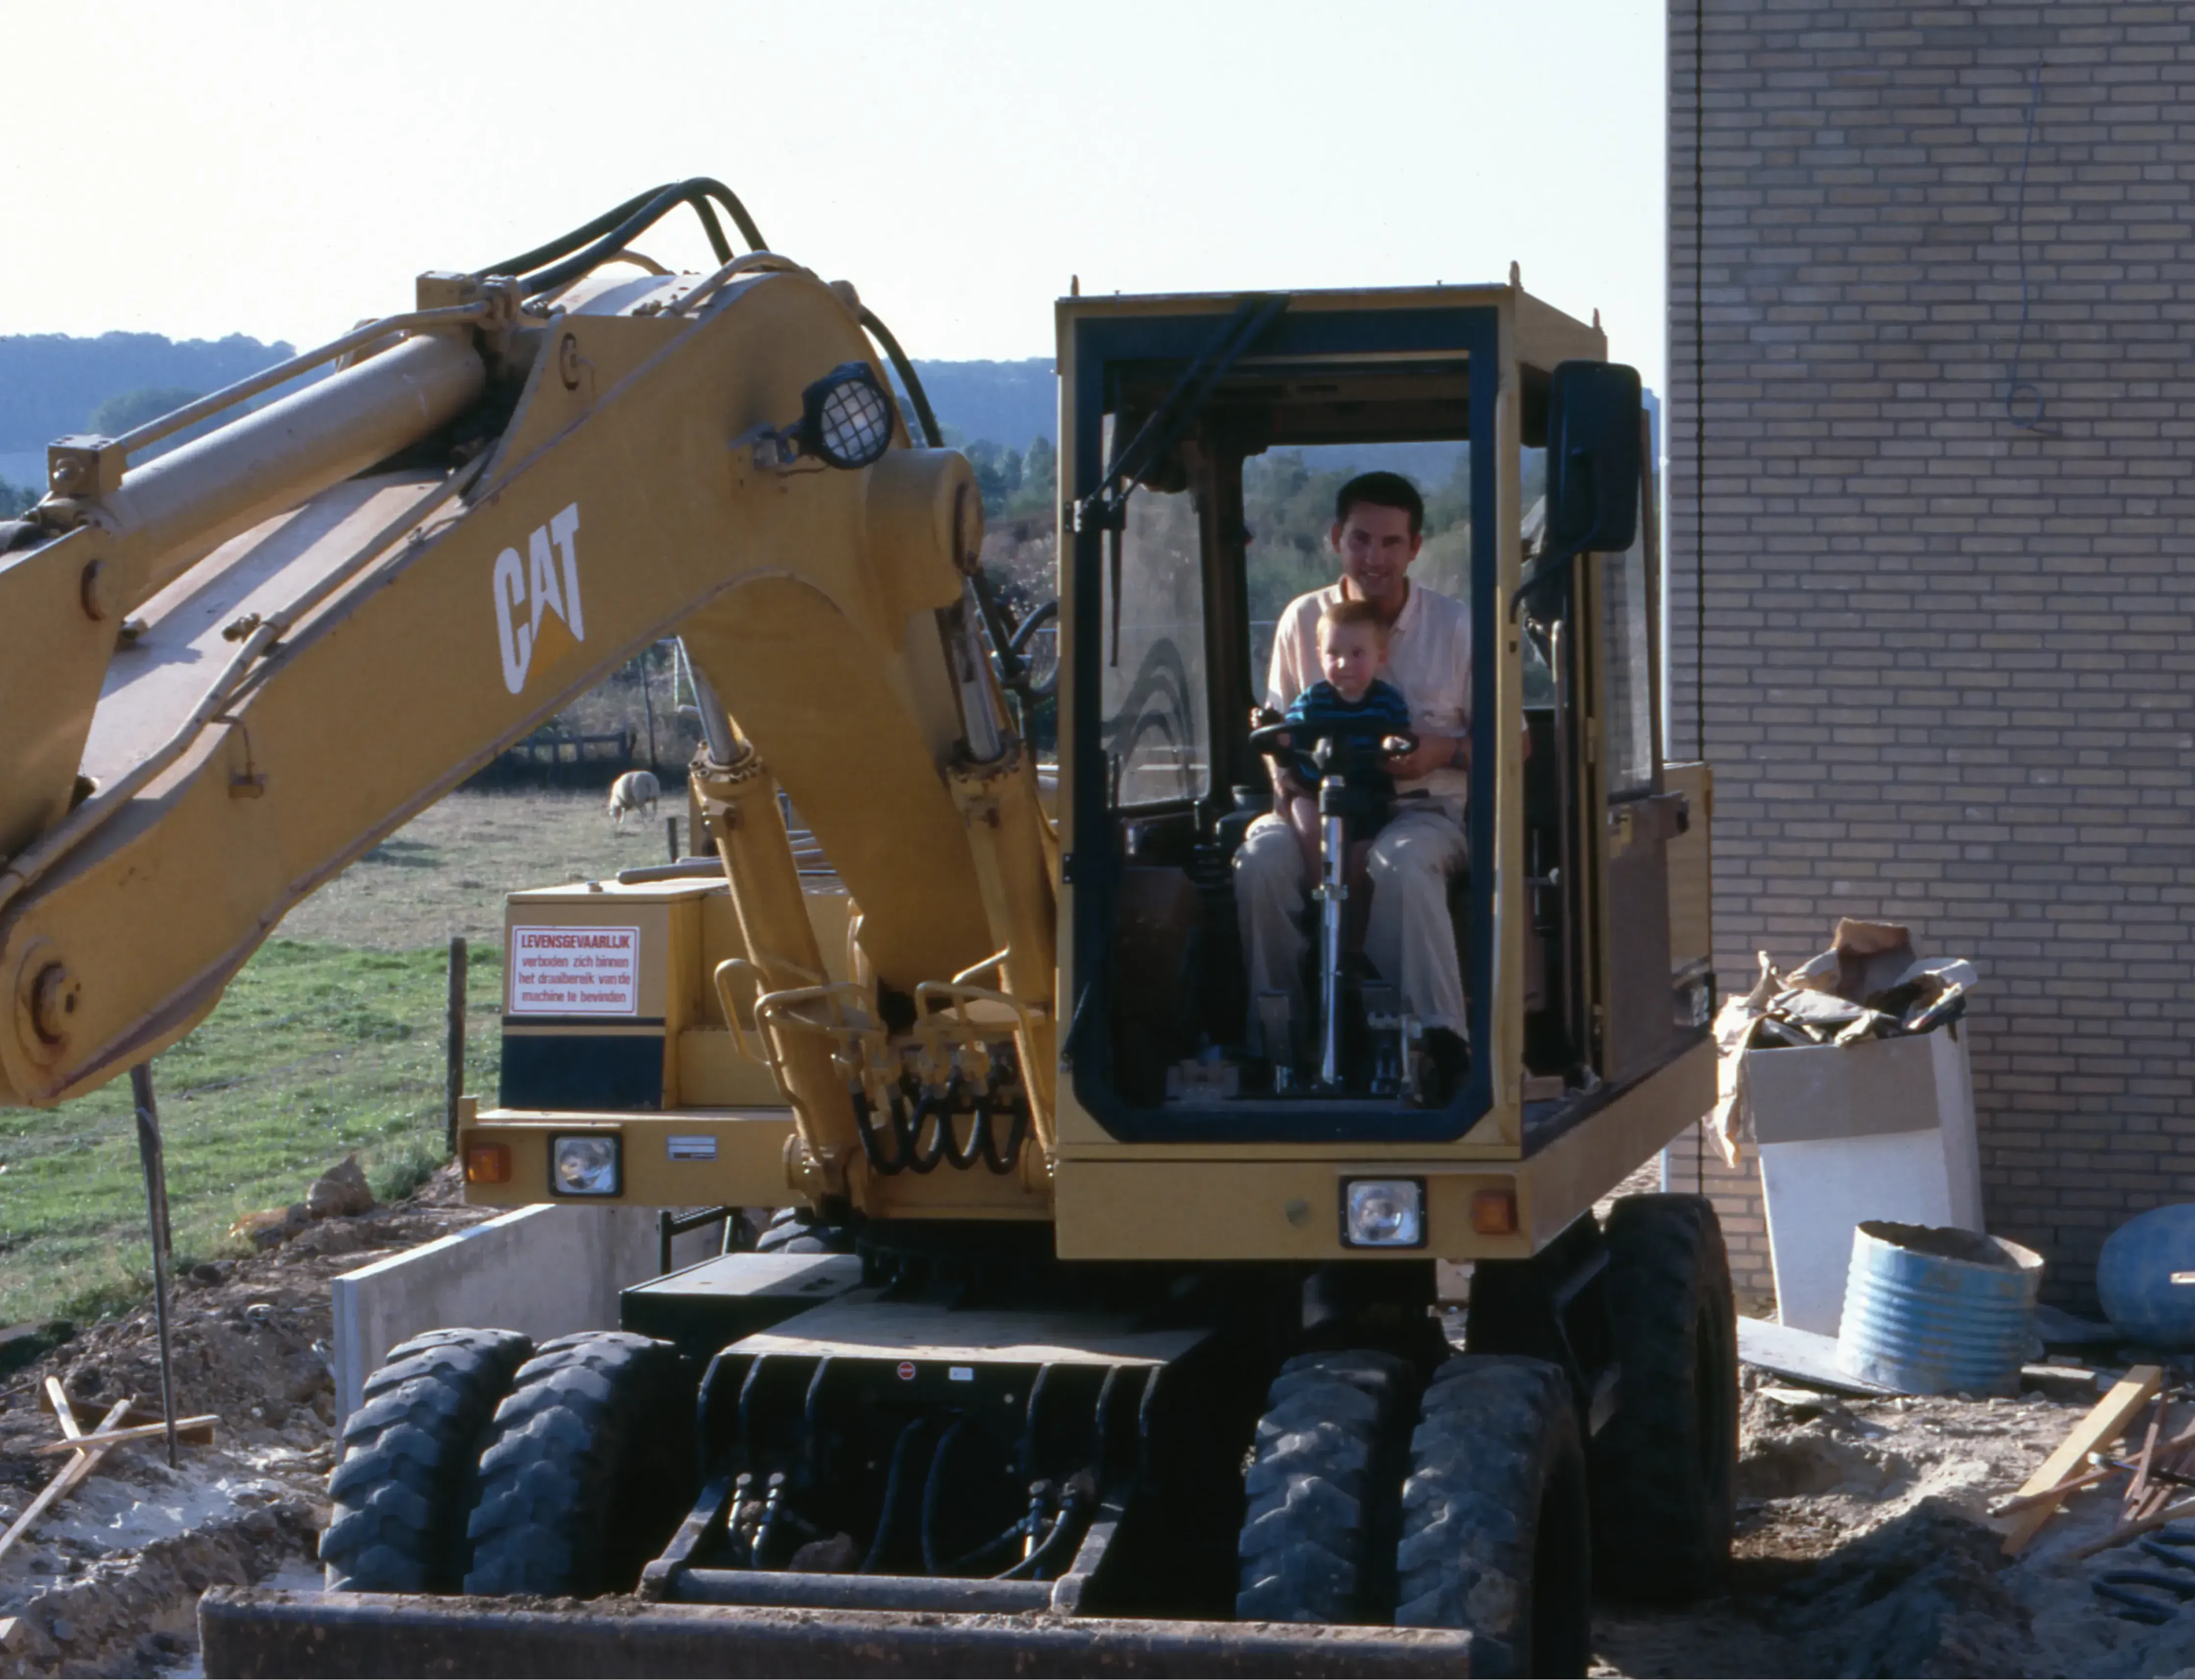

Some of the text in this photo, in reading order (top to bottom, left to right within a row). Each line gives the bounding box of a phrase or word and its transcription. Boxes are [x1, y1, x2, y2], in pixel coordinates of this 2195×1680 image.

[493, 501, 584, 695] CAT
[522, 955, 629, 968] verboden zich binnen
[519, 972, 535, 984] het
[599, 974, 617, 984] van
[619, 972, 631, 985] de
[522, 990, 627, 1003] machine te bevinden
